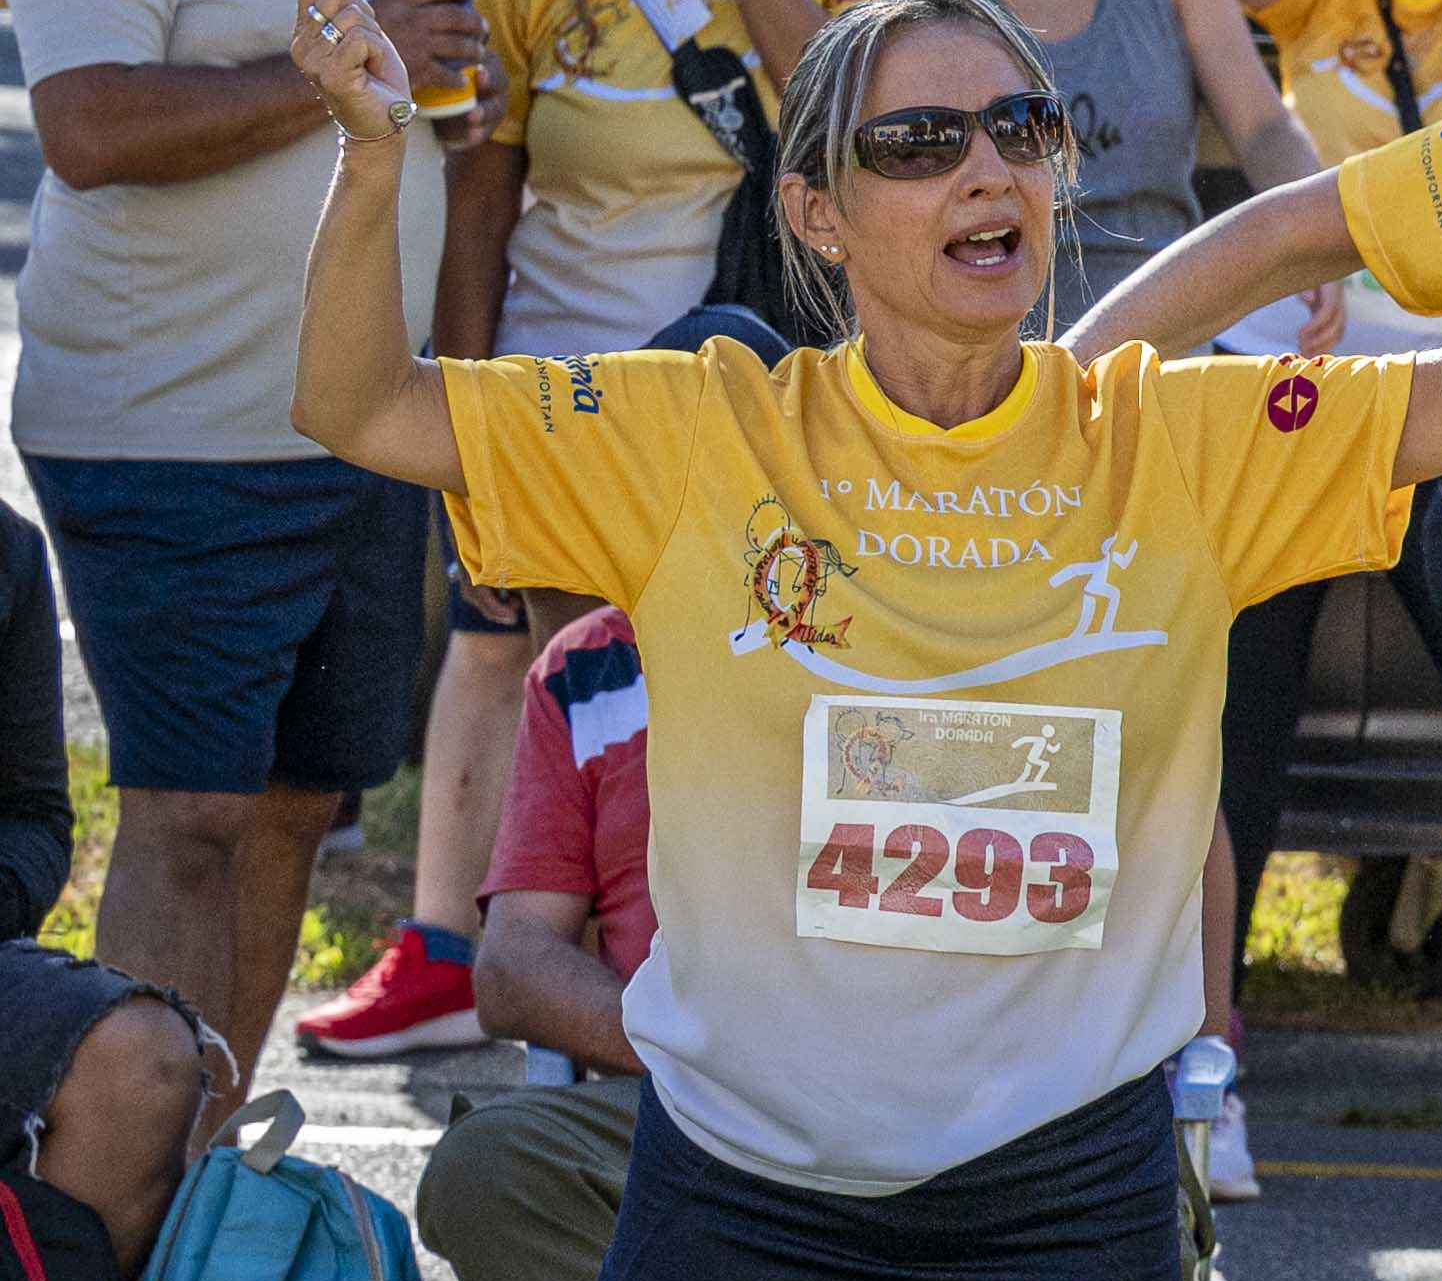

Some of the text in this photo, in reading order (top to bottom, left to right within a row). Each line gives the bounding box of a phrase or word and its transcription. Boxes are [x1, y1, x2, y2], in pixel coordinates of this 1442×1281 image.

[863, 478, 1082, 519] MARATÓN
[856, 528, 1053, 569] DORADA
[935, 728, 994, 744] DORADA
[806, 822, 1095, 924] 4293
